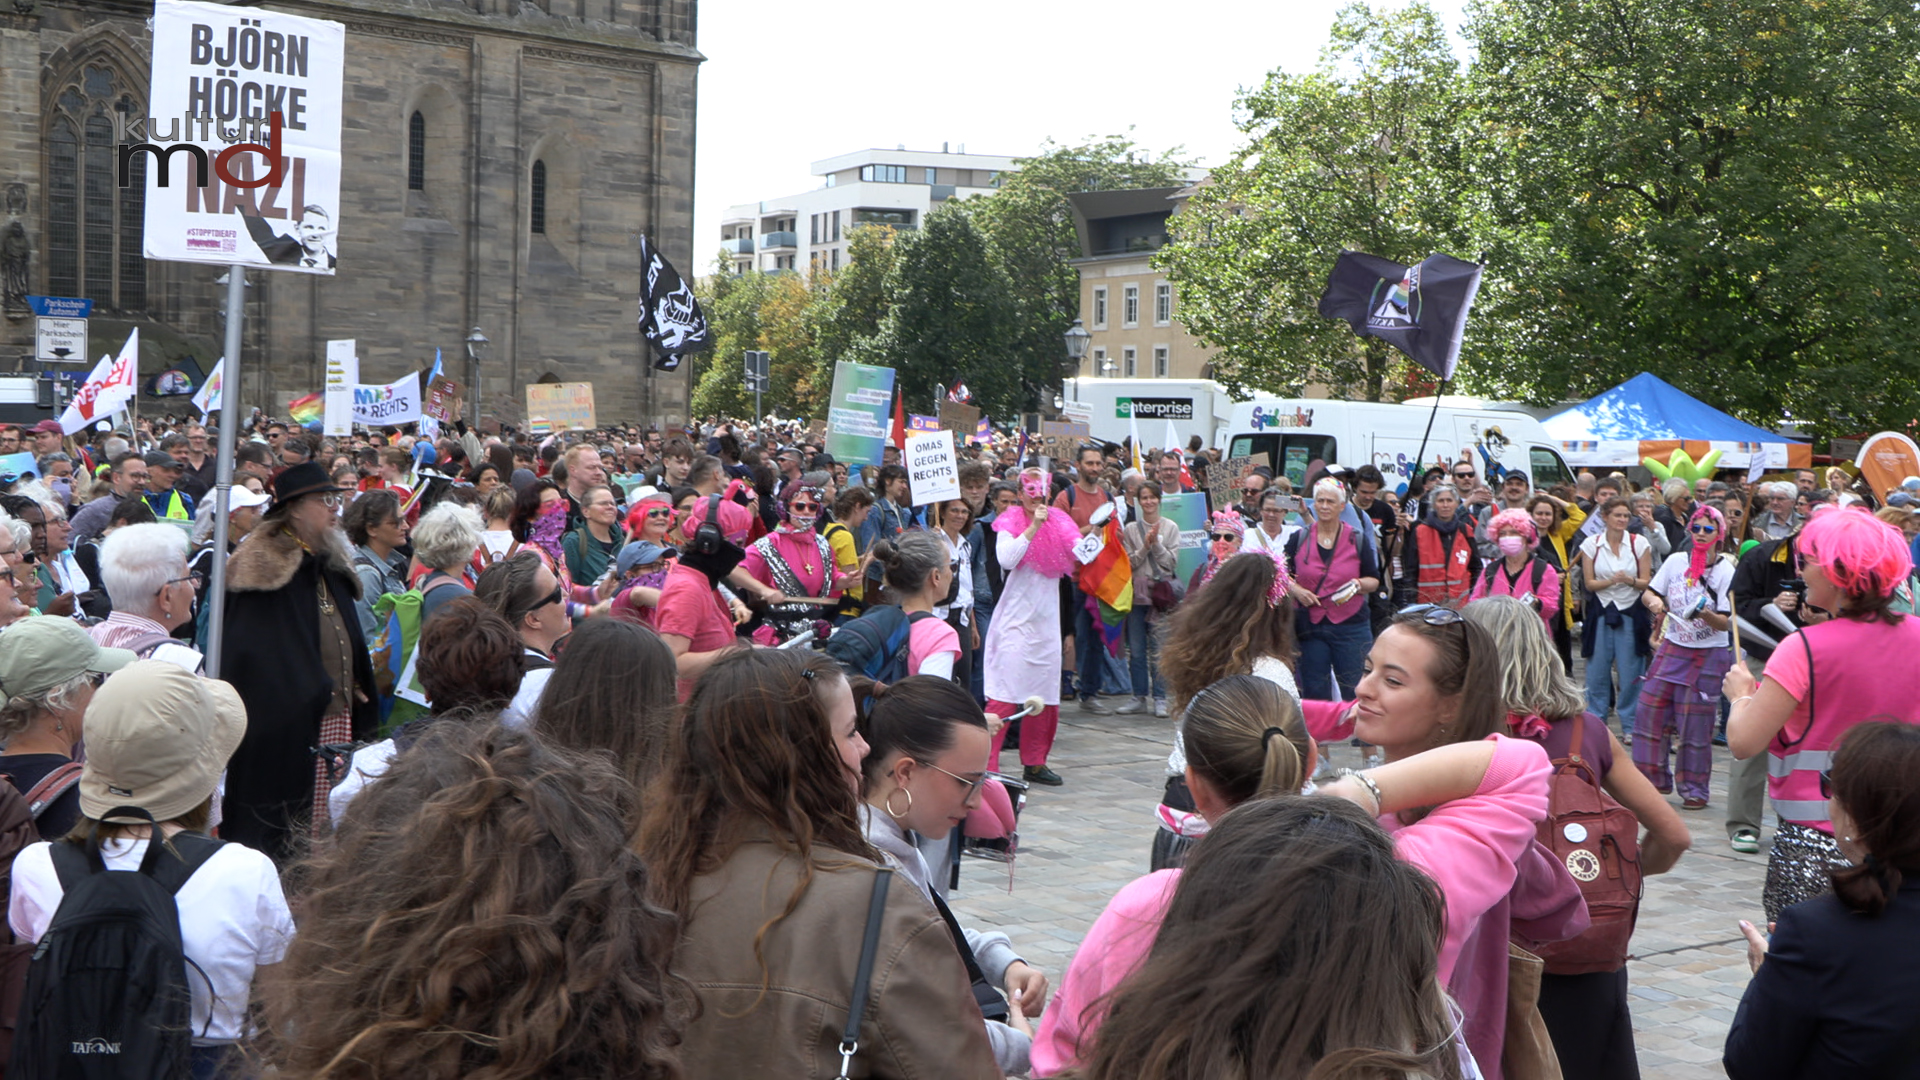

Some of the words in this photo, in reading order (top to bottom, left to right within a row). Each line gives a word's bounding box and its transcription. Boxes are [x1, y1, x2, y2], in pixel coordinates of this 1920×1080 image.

[190, 19, 309, 77] BJÖRN
[188, 69, 307, 131] HÖCKE
[186, 148, 307, 221] NAZI
[44, 298, 86, 309] Parkschein
[48, 307, 80, 316] Automat
[40, 329, 84, 338] Parkschein
[51, 338, 73, 346] lösen
[370, 397, 409, 418] RECHTS
[1120, 401, 1192, 416] enterprise
[915, 440, 943, 453] OMAS
[914, 453, 947, 467] GEGEN
[913, 466, 952, 481] RECHTS
